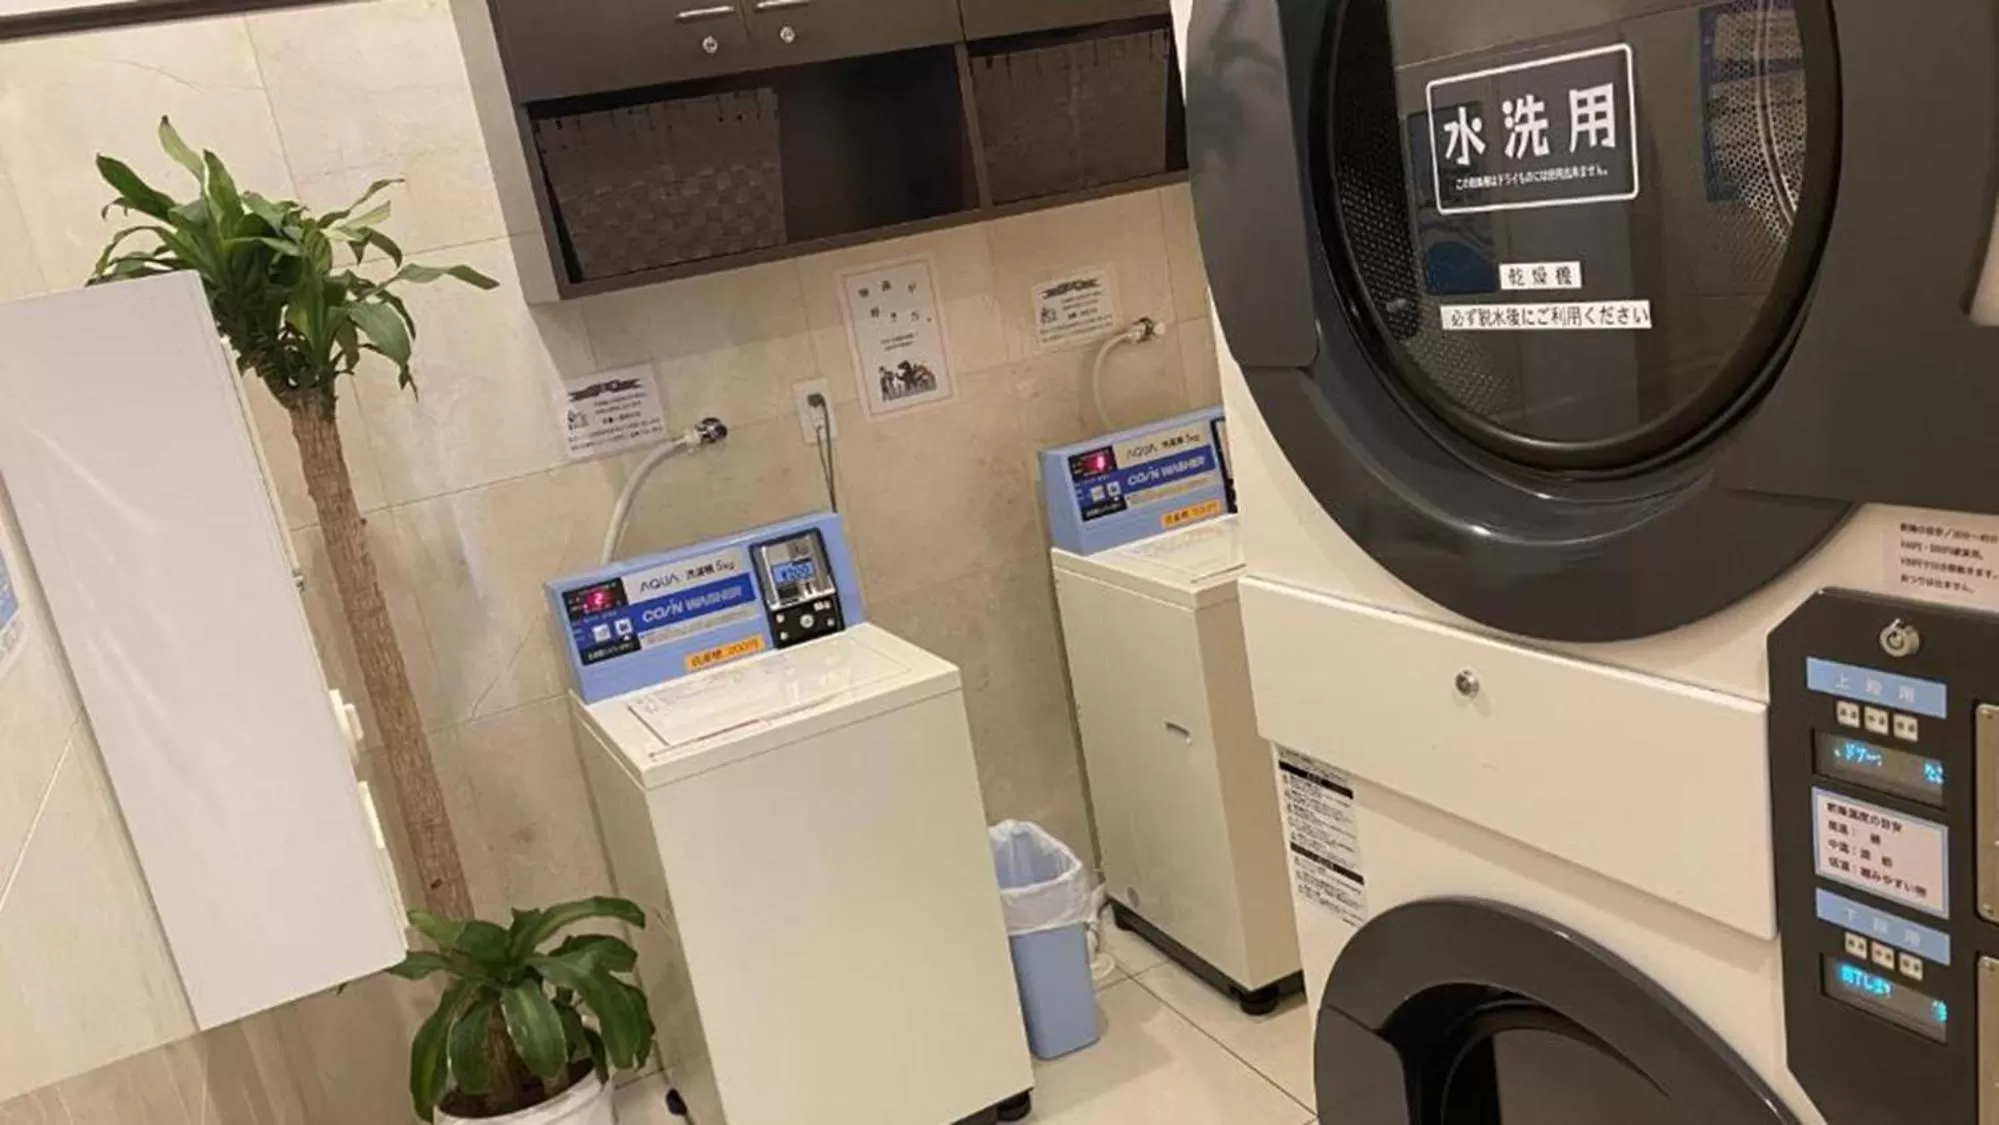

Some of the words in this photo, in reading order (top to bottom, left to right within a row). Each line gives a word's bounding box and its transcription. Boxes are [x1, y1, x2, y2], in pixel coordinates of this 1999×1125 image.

[1444, 83, 1616, 166] 水洗用
[1508, 266, 1573, 287] 乾燥機
[1451, 306, 1649, 327] 必ず脱水後にご利用ください
[1127, 466, 1160, 486] COIN
[640, 573, 679, 593] AQUA
[641, 598, 684, 623] COIN
[685, 586, 743, 611] WASHER
